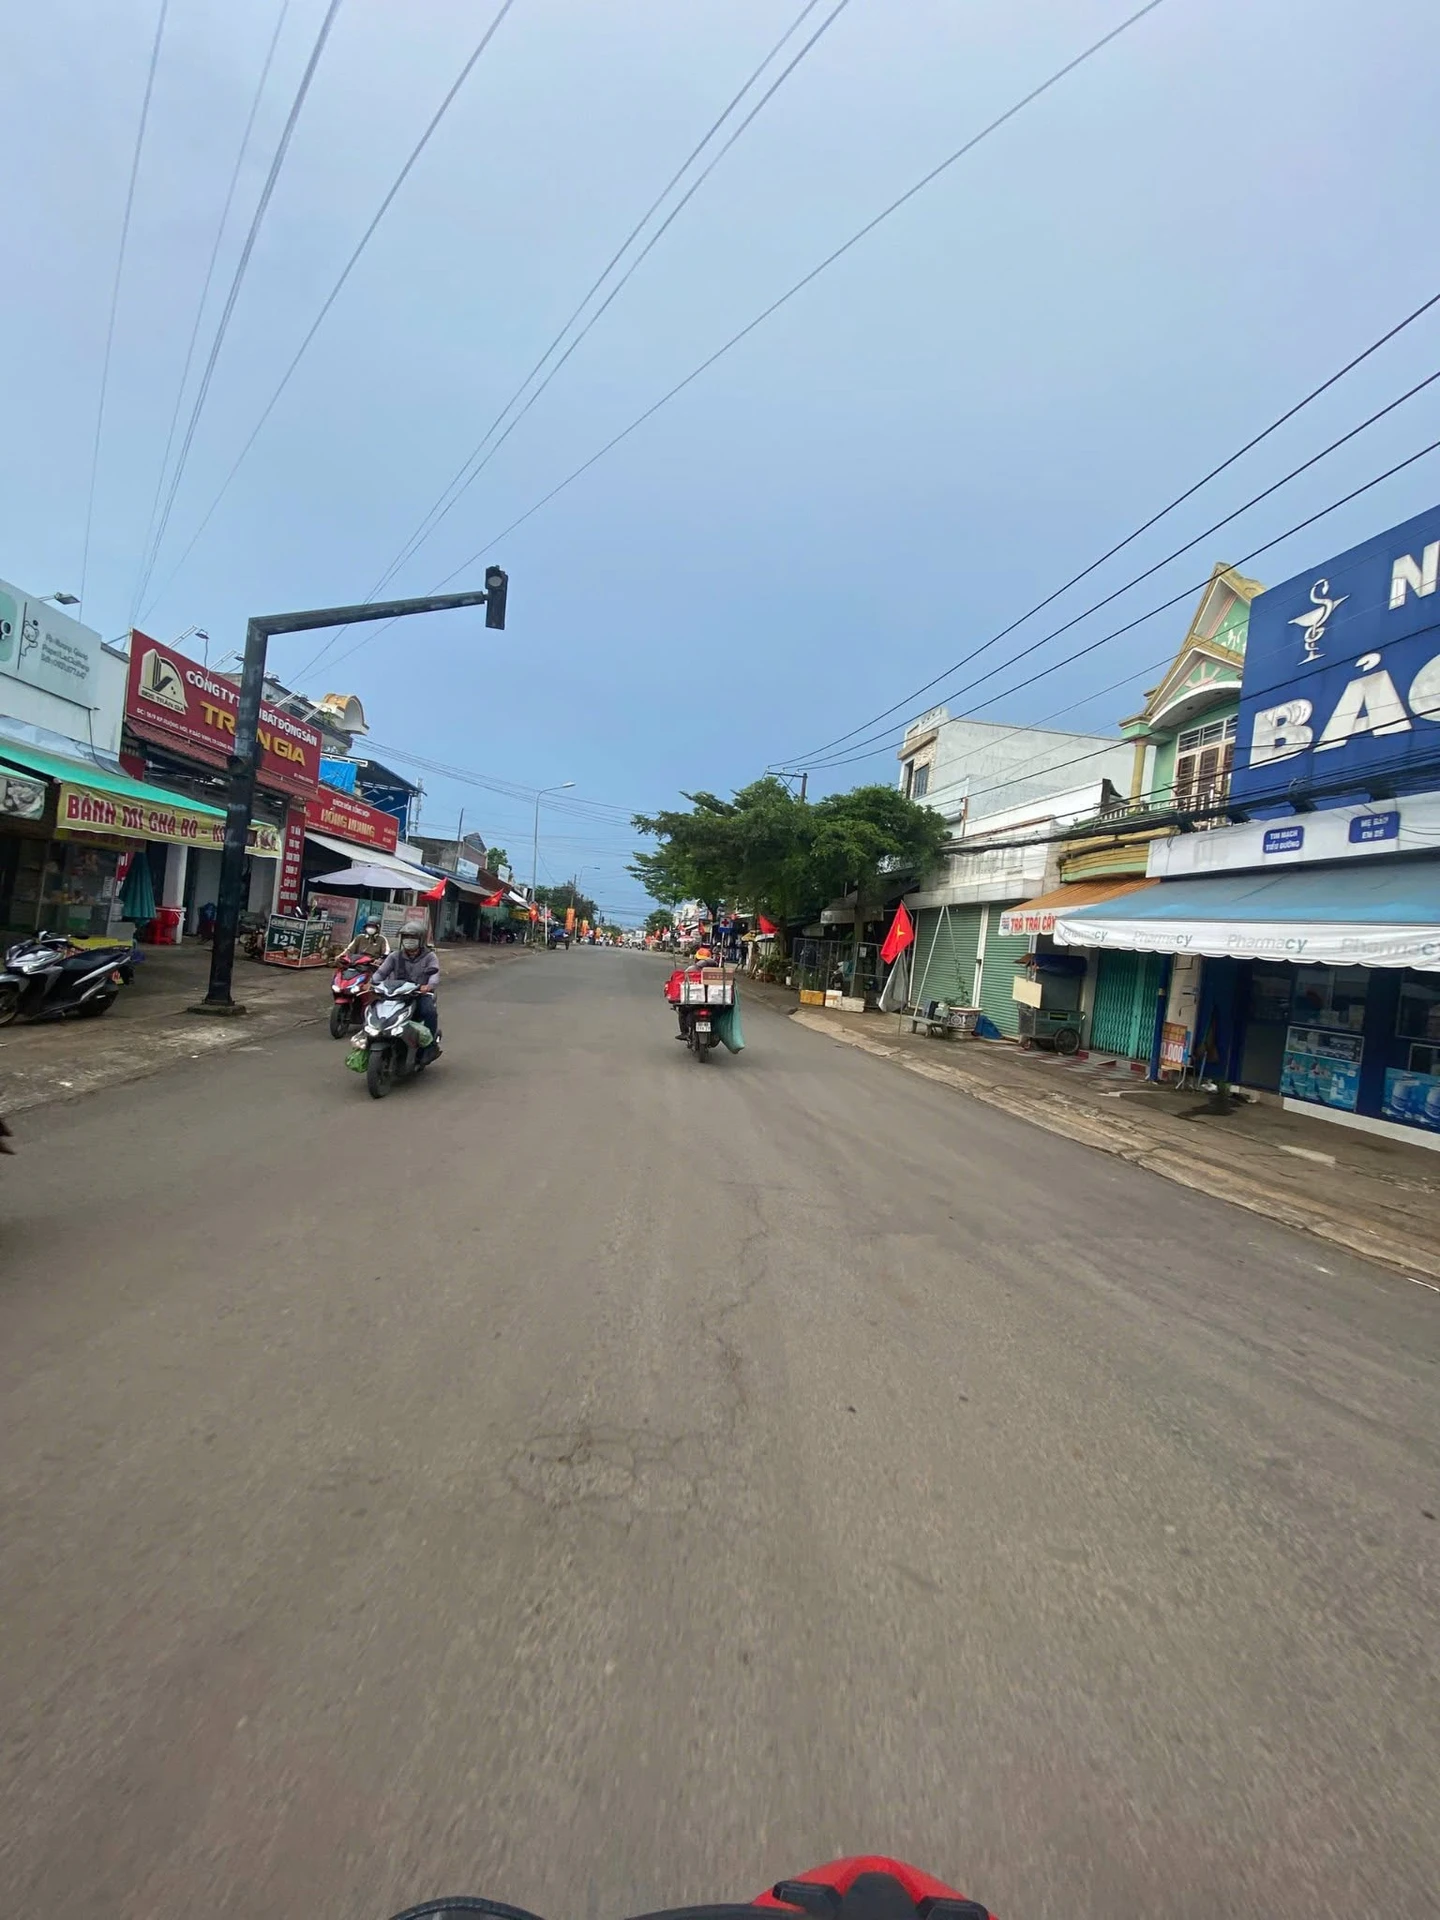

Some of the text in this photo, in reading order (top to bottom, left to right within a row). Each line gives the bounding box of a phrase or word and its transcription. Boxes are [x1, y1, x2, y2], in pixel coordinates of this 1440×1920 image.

[185, 669, 220, 698] CÔNG
[220, 684, 236, 705] TY
[200, 700, 271, 751] TRN
[261, 709, 278, 728] BẤT
[277, 718, 303, 738] ĐỘNG
[302, 728, 318, 747] SẢN
[273, 736, 306, 767] GIA
[66, 792, 117, 826] BÁNH
[149, 809, 176, 837] CHẢ
[180, 815, 198, 839] BÒ
[1010, 912, 1024, 933] TRÀ
[1025, 911, 1041, 932] TRÁI
[1062, 928, 1109, 942] Pharmacy
[1132, 930, 1194, 947] Pharmacy
[1225, 933, 1309, 954] Pharmacy
